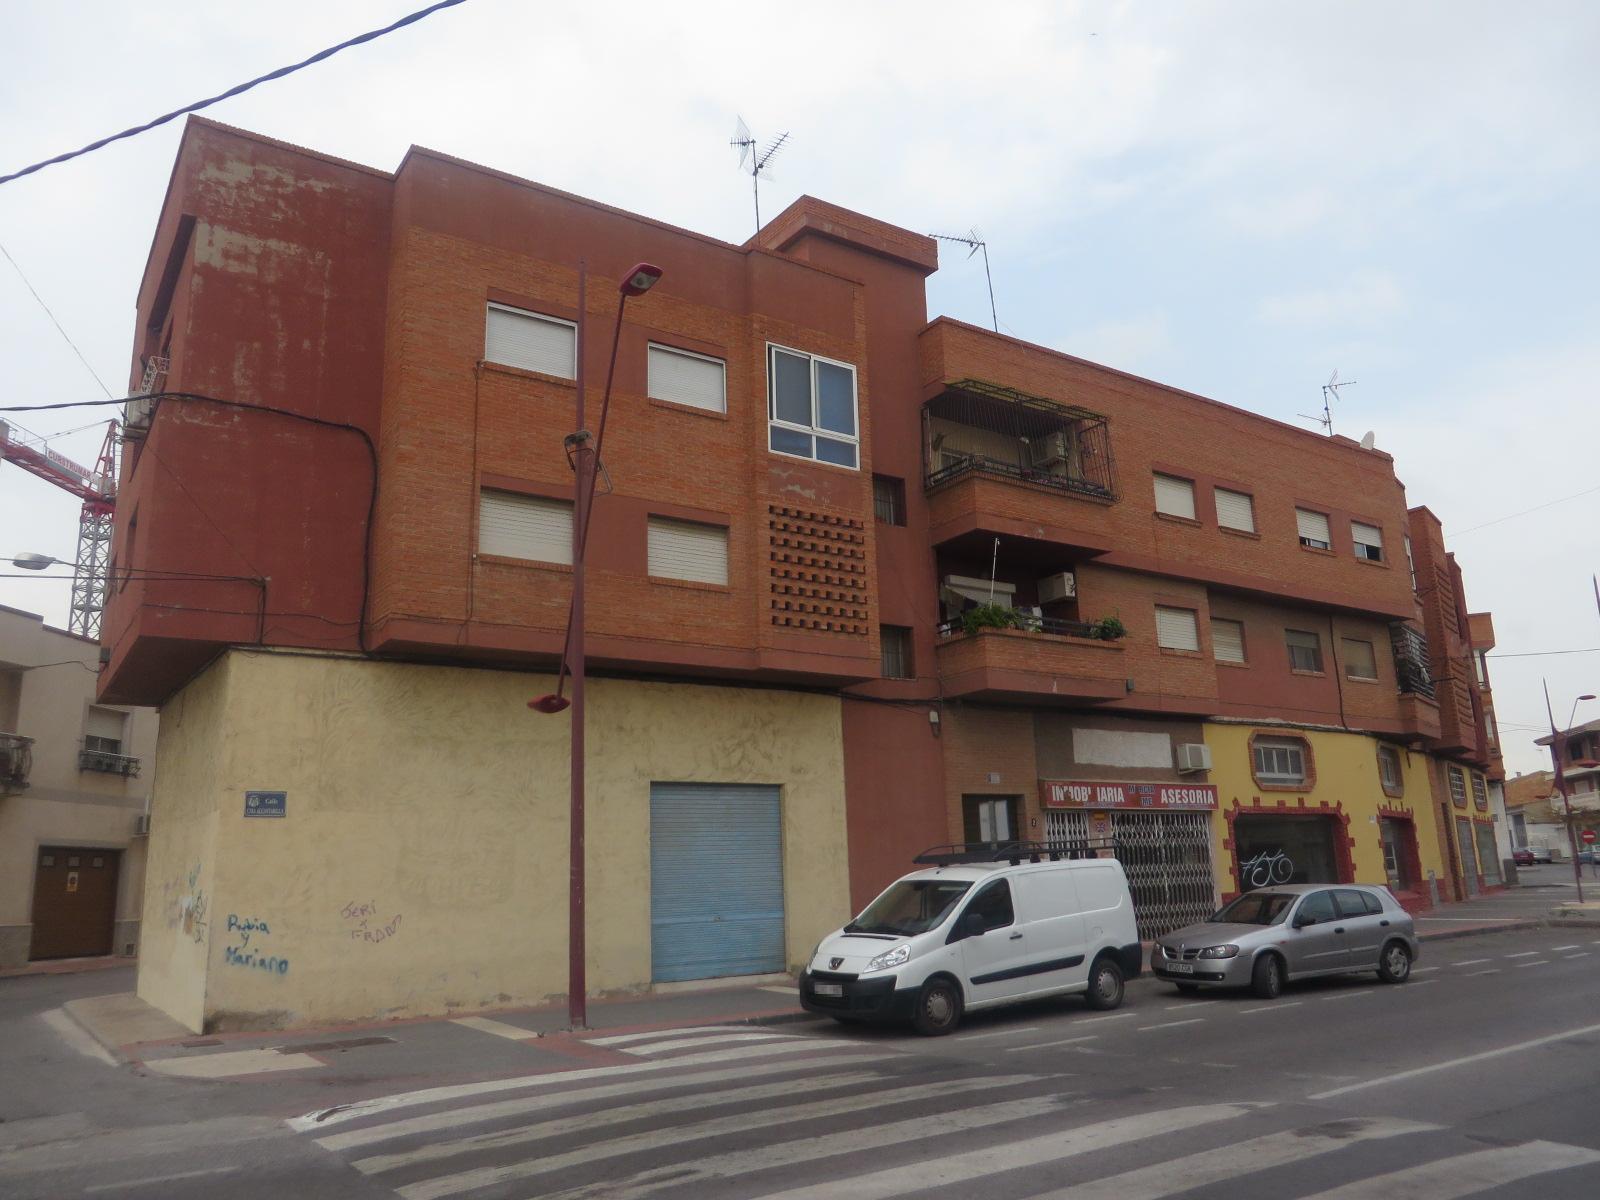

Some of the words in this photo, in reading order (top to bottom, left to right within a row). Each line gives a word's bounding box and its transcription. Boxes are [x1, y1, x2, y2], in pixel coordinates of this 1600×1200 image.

[1051, 786, 1125, 803] INMOBIIARIA
[1160, 788, 1214, 804] ASESORIA
[224, 946, 289, 976] Mariano
